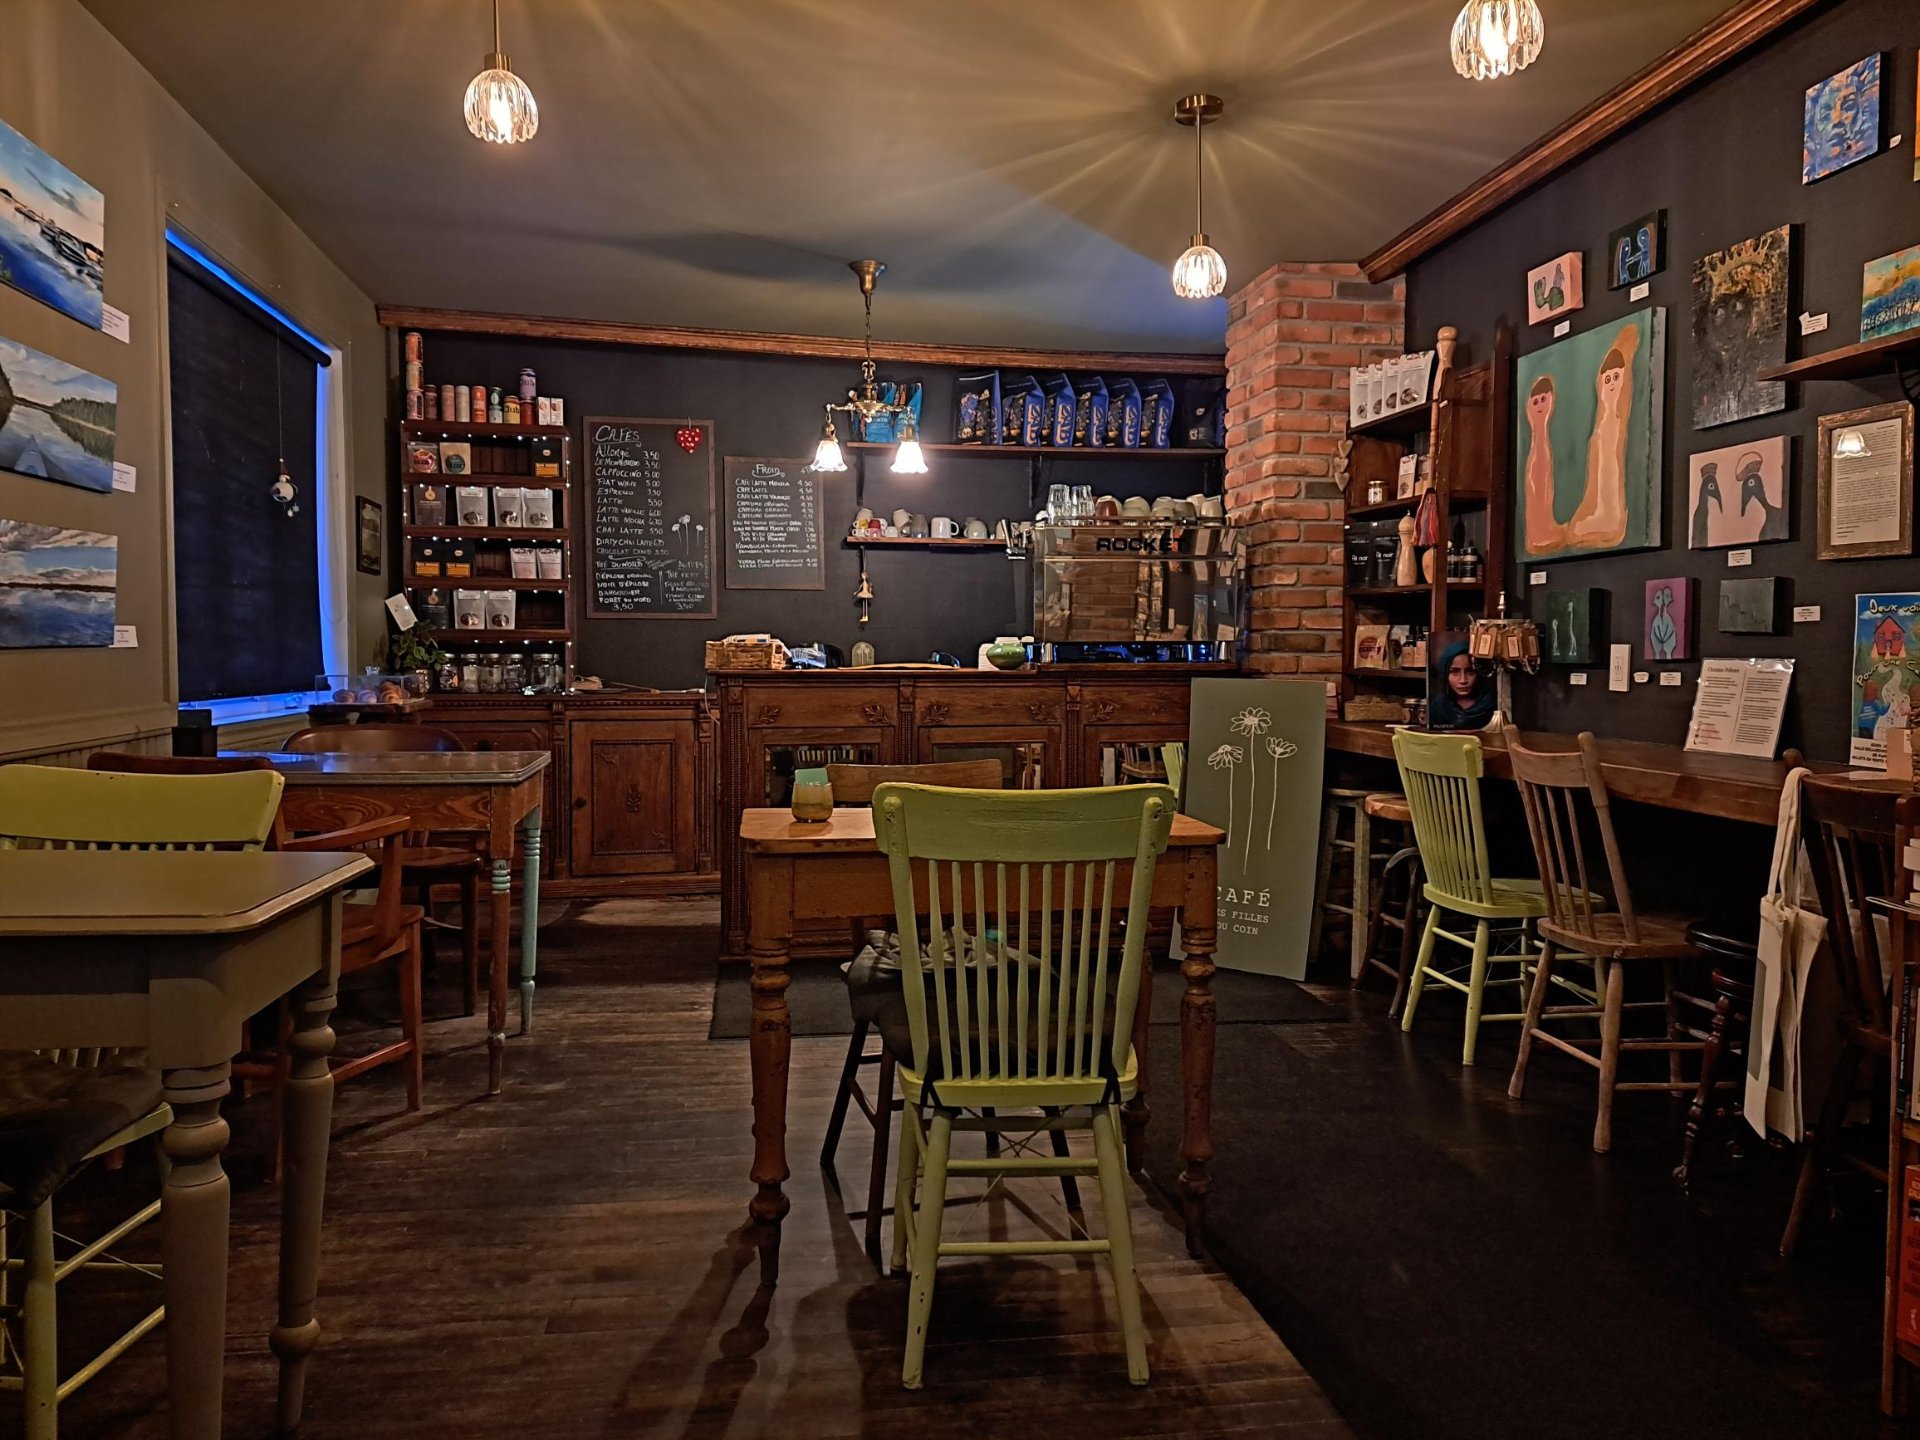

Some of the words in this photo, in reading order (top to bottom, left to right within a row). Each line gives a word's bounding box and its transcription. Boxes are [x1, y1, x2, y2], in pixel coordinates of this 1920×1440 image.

[595, 467, 641, 478] CAPPUCCINO
[756, 463, 780, 474] FROID
[597, 497, 623, 505] LATTE
[597, 506, 619, 514] LATTE
[597, 514, 619, 523] LATTE
[596, 526, 615, 534] CHAI
[1096, 537, 1186, 552] ROCKET
[1868, 598, 1898, 614] Deux
[1902, 604, 1920, 613] voi
[1232, 911, 1269, 924] FILLES
[1233, 924, 1259, 935] COIN
